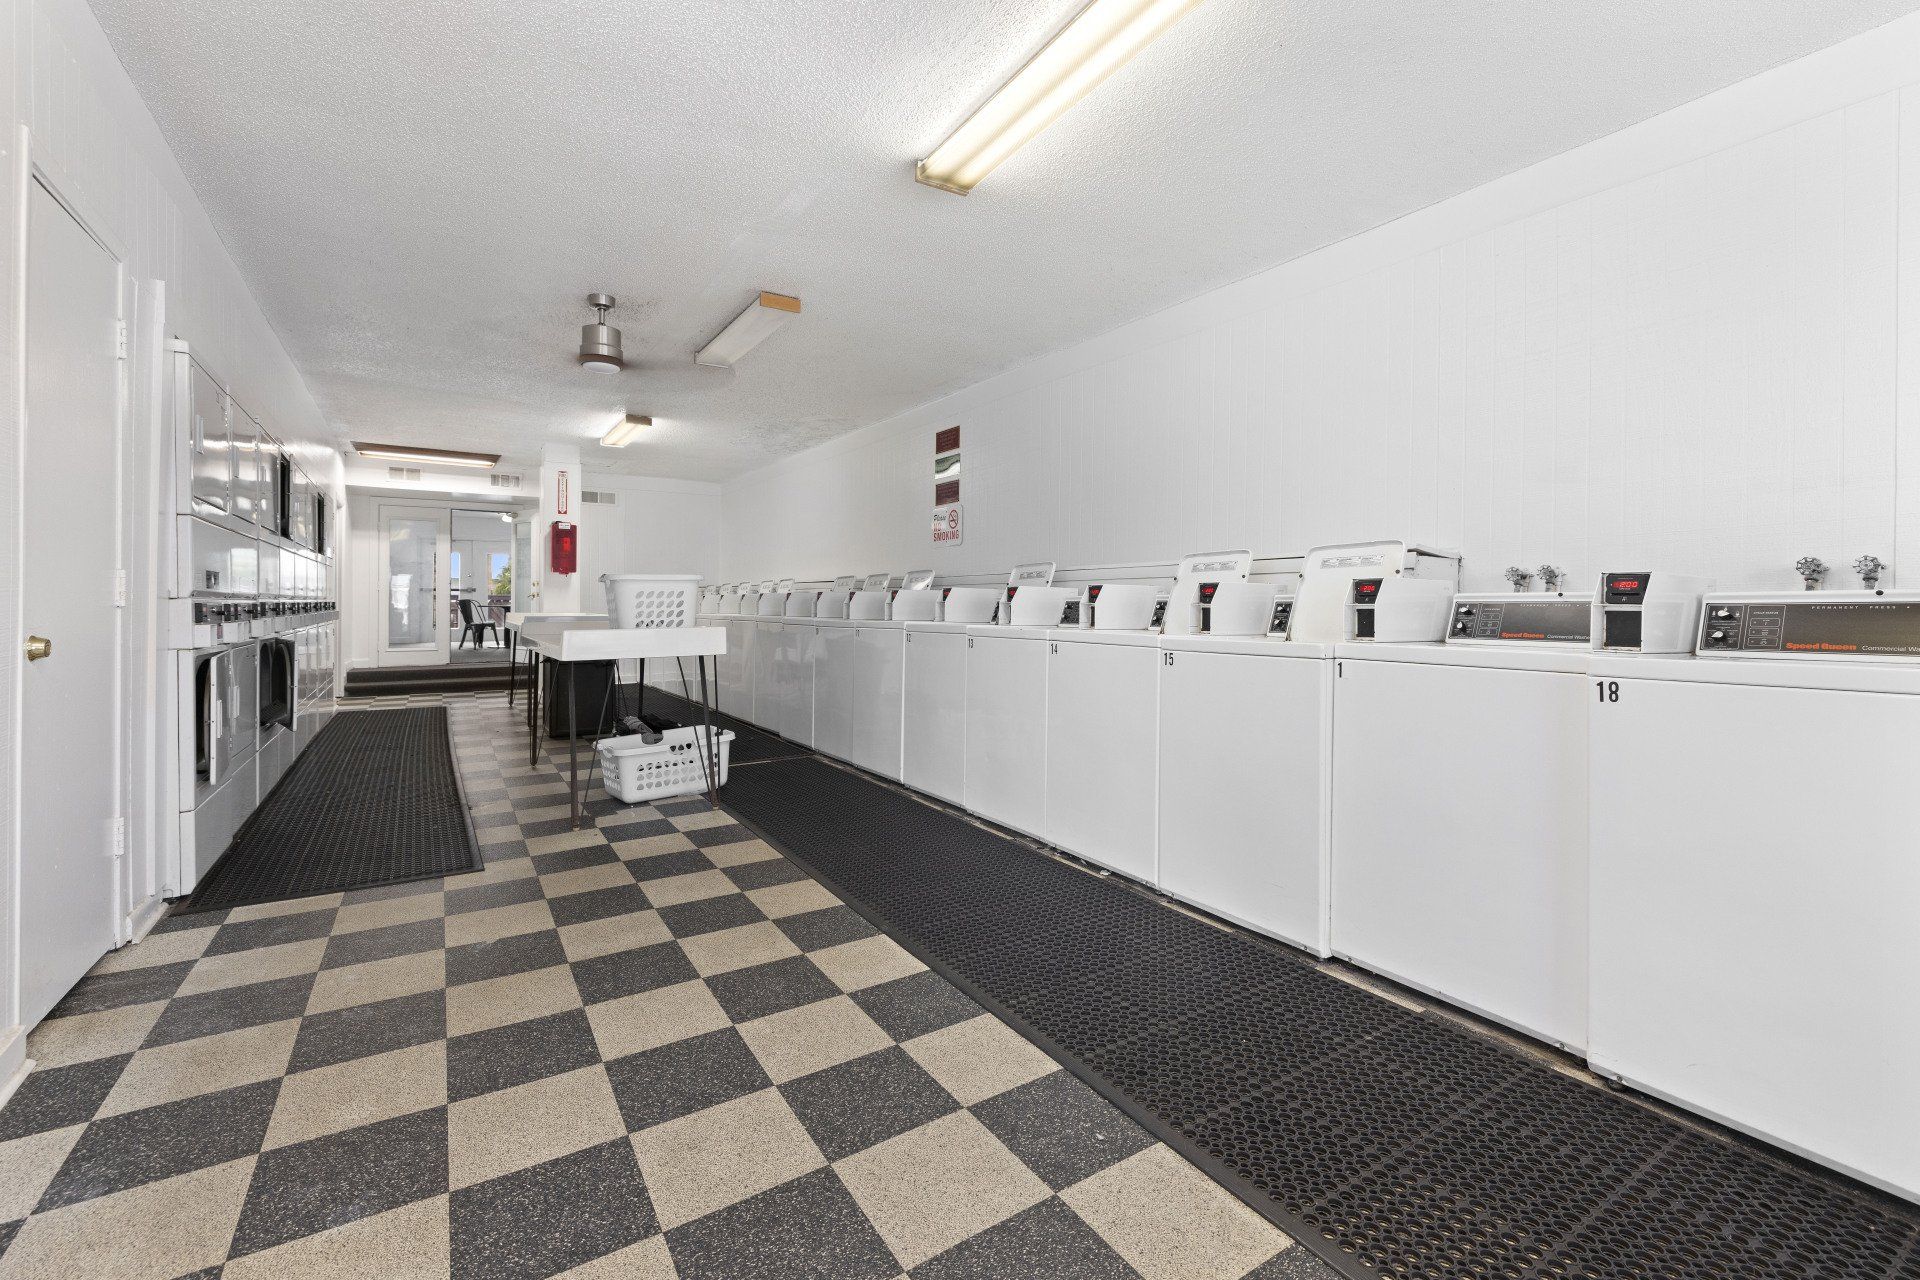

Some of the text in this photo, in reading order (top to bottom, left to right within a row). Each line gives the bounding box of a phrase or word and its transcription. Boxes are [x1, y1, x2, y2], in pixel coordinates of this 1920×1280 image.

[934, 530, 960, 541] SMOKING
[968, 638, 974, 649] 13
[1050, 643, 1058, 655] 14
[1786, 642, 1820, 650] Speed
[1821, 642, 1857, 651] Queen
[1164, 652, 1174, 666] 15
[1337, 661, 1342, 678] 1
[1596, 681, 1619, 702] 18
